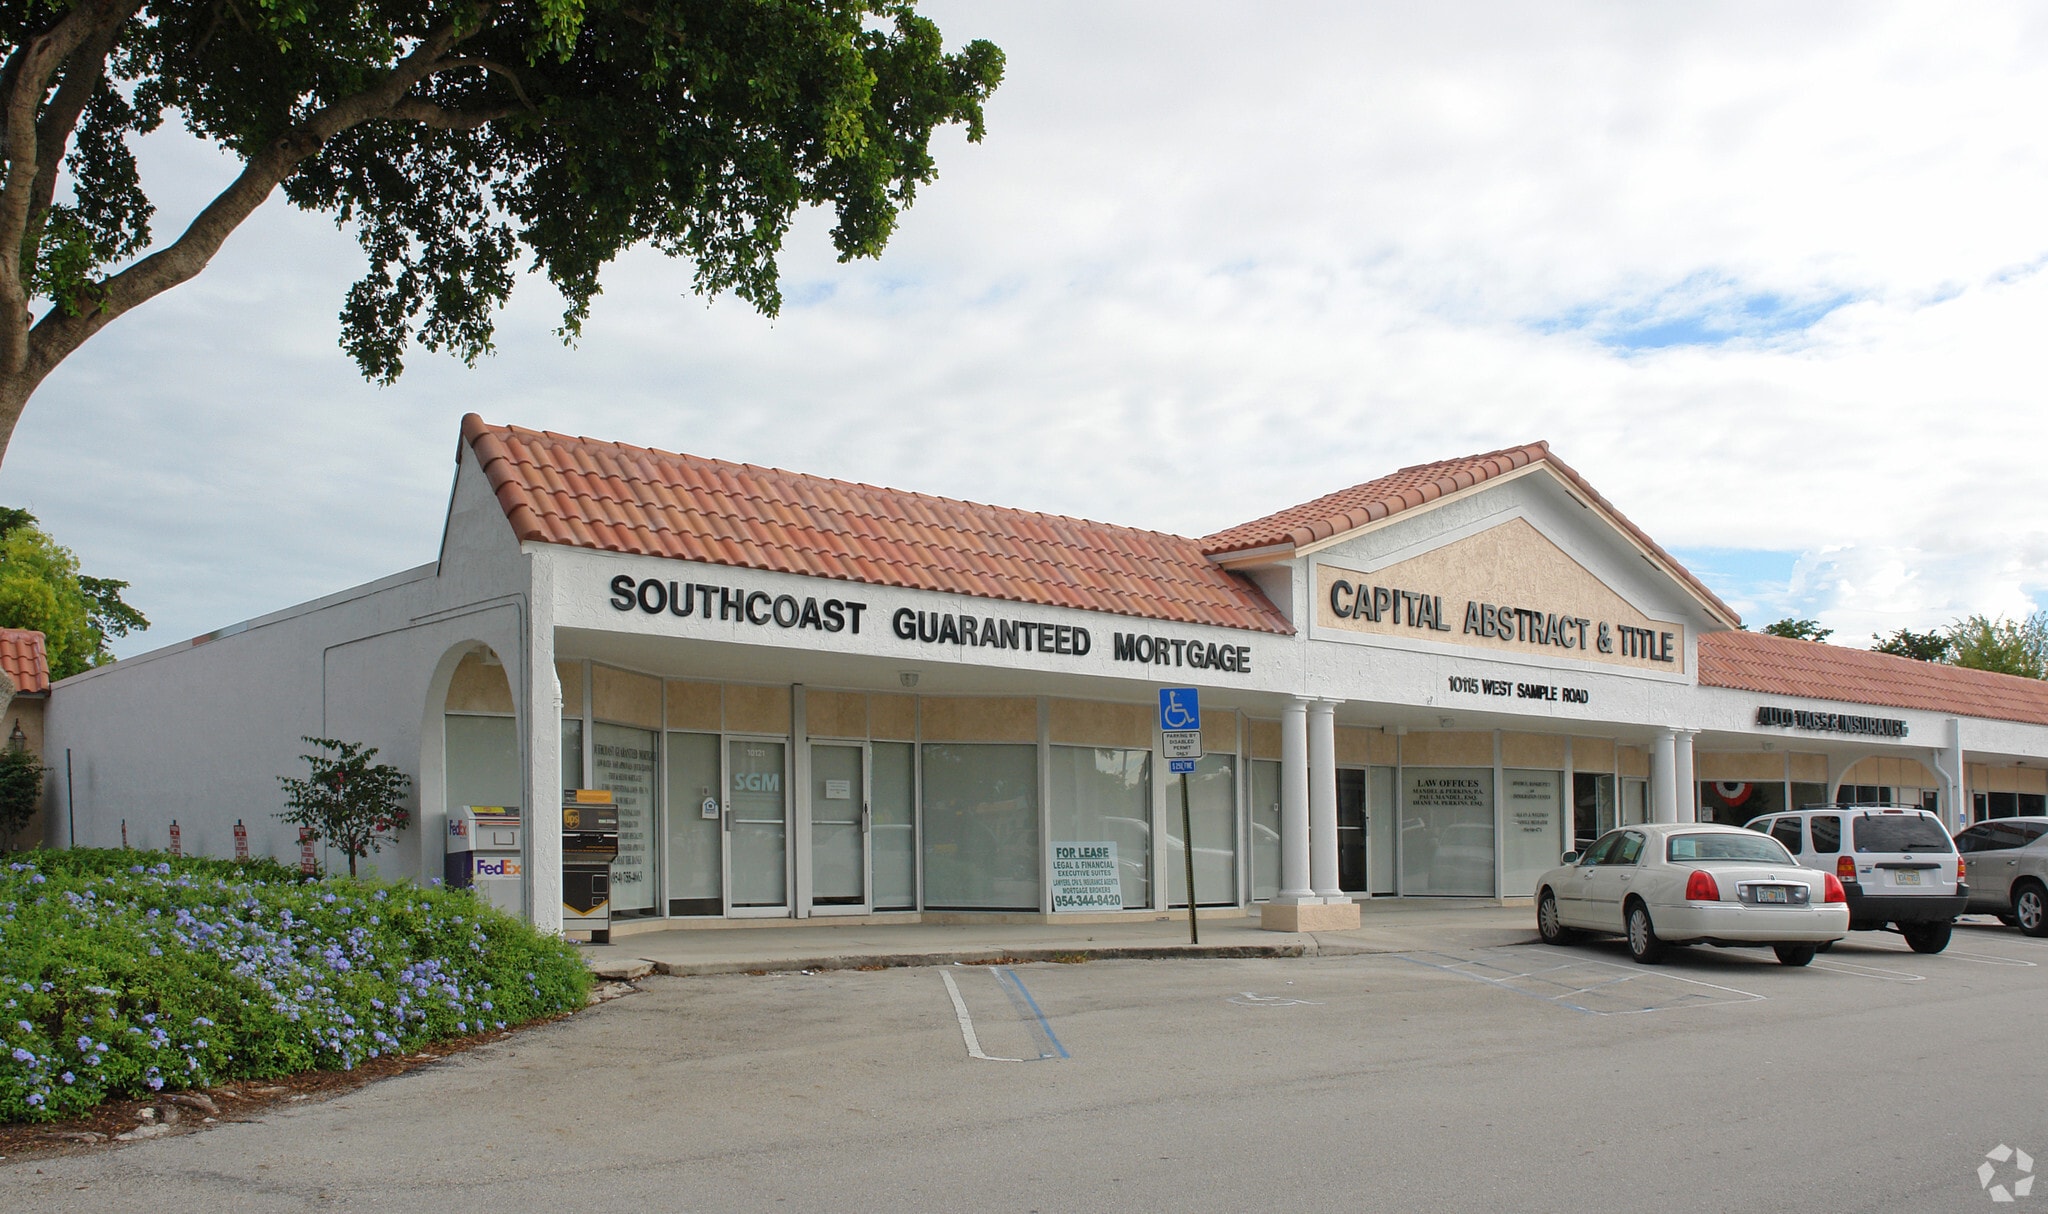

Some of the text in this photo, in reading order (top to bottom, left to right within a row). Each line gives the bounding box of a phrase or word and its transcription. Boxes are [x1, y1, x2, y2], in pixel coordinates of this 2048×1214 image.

[610, 574, 1251, 673] SOUTHCOAST GUARANTEED MORTGAGE
[1331, 580, 1675, 662] CAPITAL ABSTRACT & TITLE
[1448, 675, 1589, 704] 10115 WEST SAMPLE ROAD
[1756, 706, 1909, 737] AUTO TAGS & INSURANCE
[747, 749, 765, 757] 10121
[734, 772, 779, 792] SGM
[1417, 779, 1479, 788] LAW OFFICES
[449, 819, 468, 836] FedEx
[566, 814, 579, 826] ups
[1056, 847, 1109, 858] FOR LEASE
[477, 859, 520, 875] FedEx
[1053, 861, 1073, 869] LEGAL
[1082, 861, 1114, 869] FINANCIAL
[1055, 895, 1121, 907] 954-344-8420
